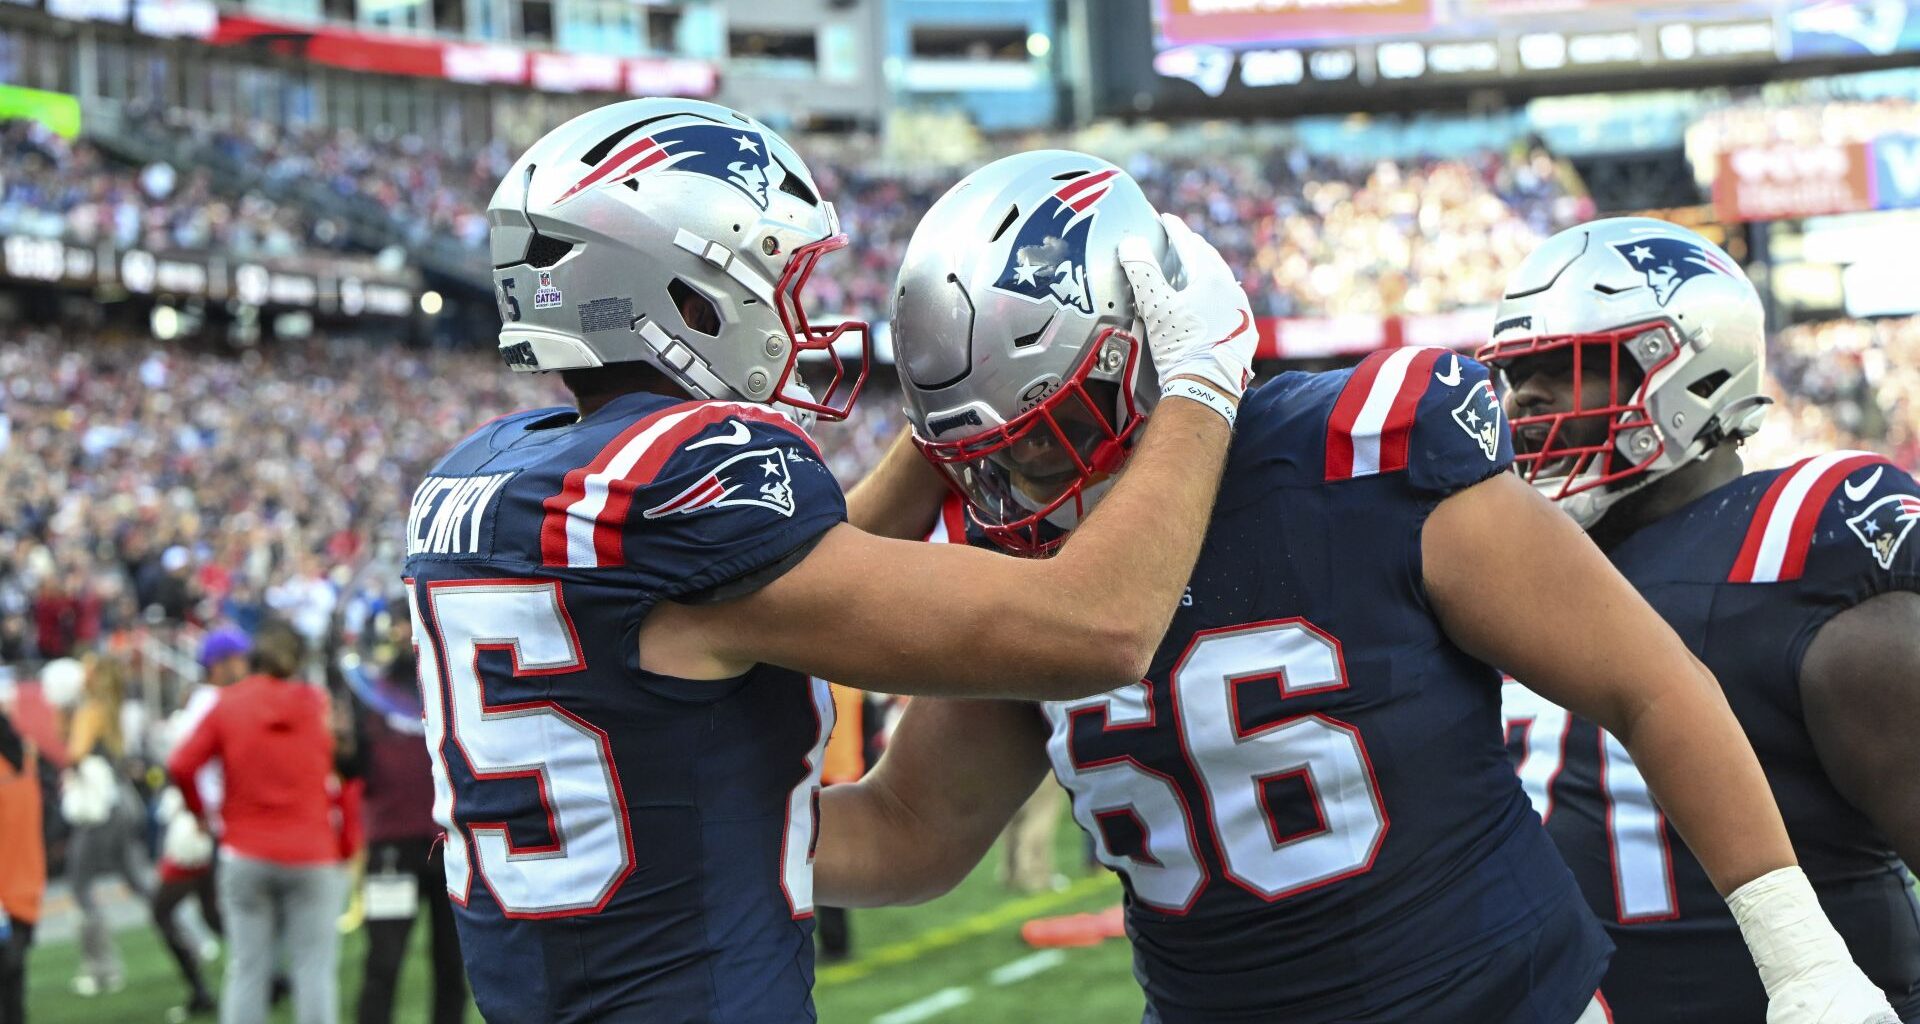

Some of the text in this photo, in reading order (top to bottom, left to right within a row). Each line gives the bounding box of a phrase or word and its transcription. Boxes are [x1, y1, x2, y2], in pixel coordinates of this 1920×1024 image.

[535, 292, 561, 303] CATCH
[1020, 383, 1060, 412] OAKLEY
[406, 472, 514, 557] HENRY
[1041, 616, 1390, 916] 66
